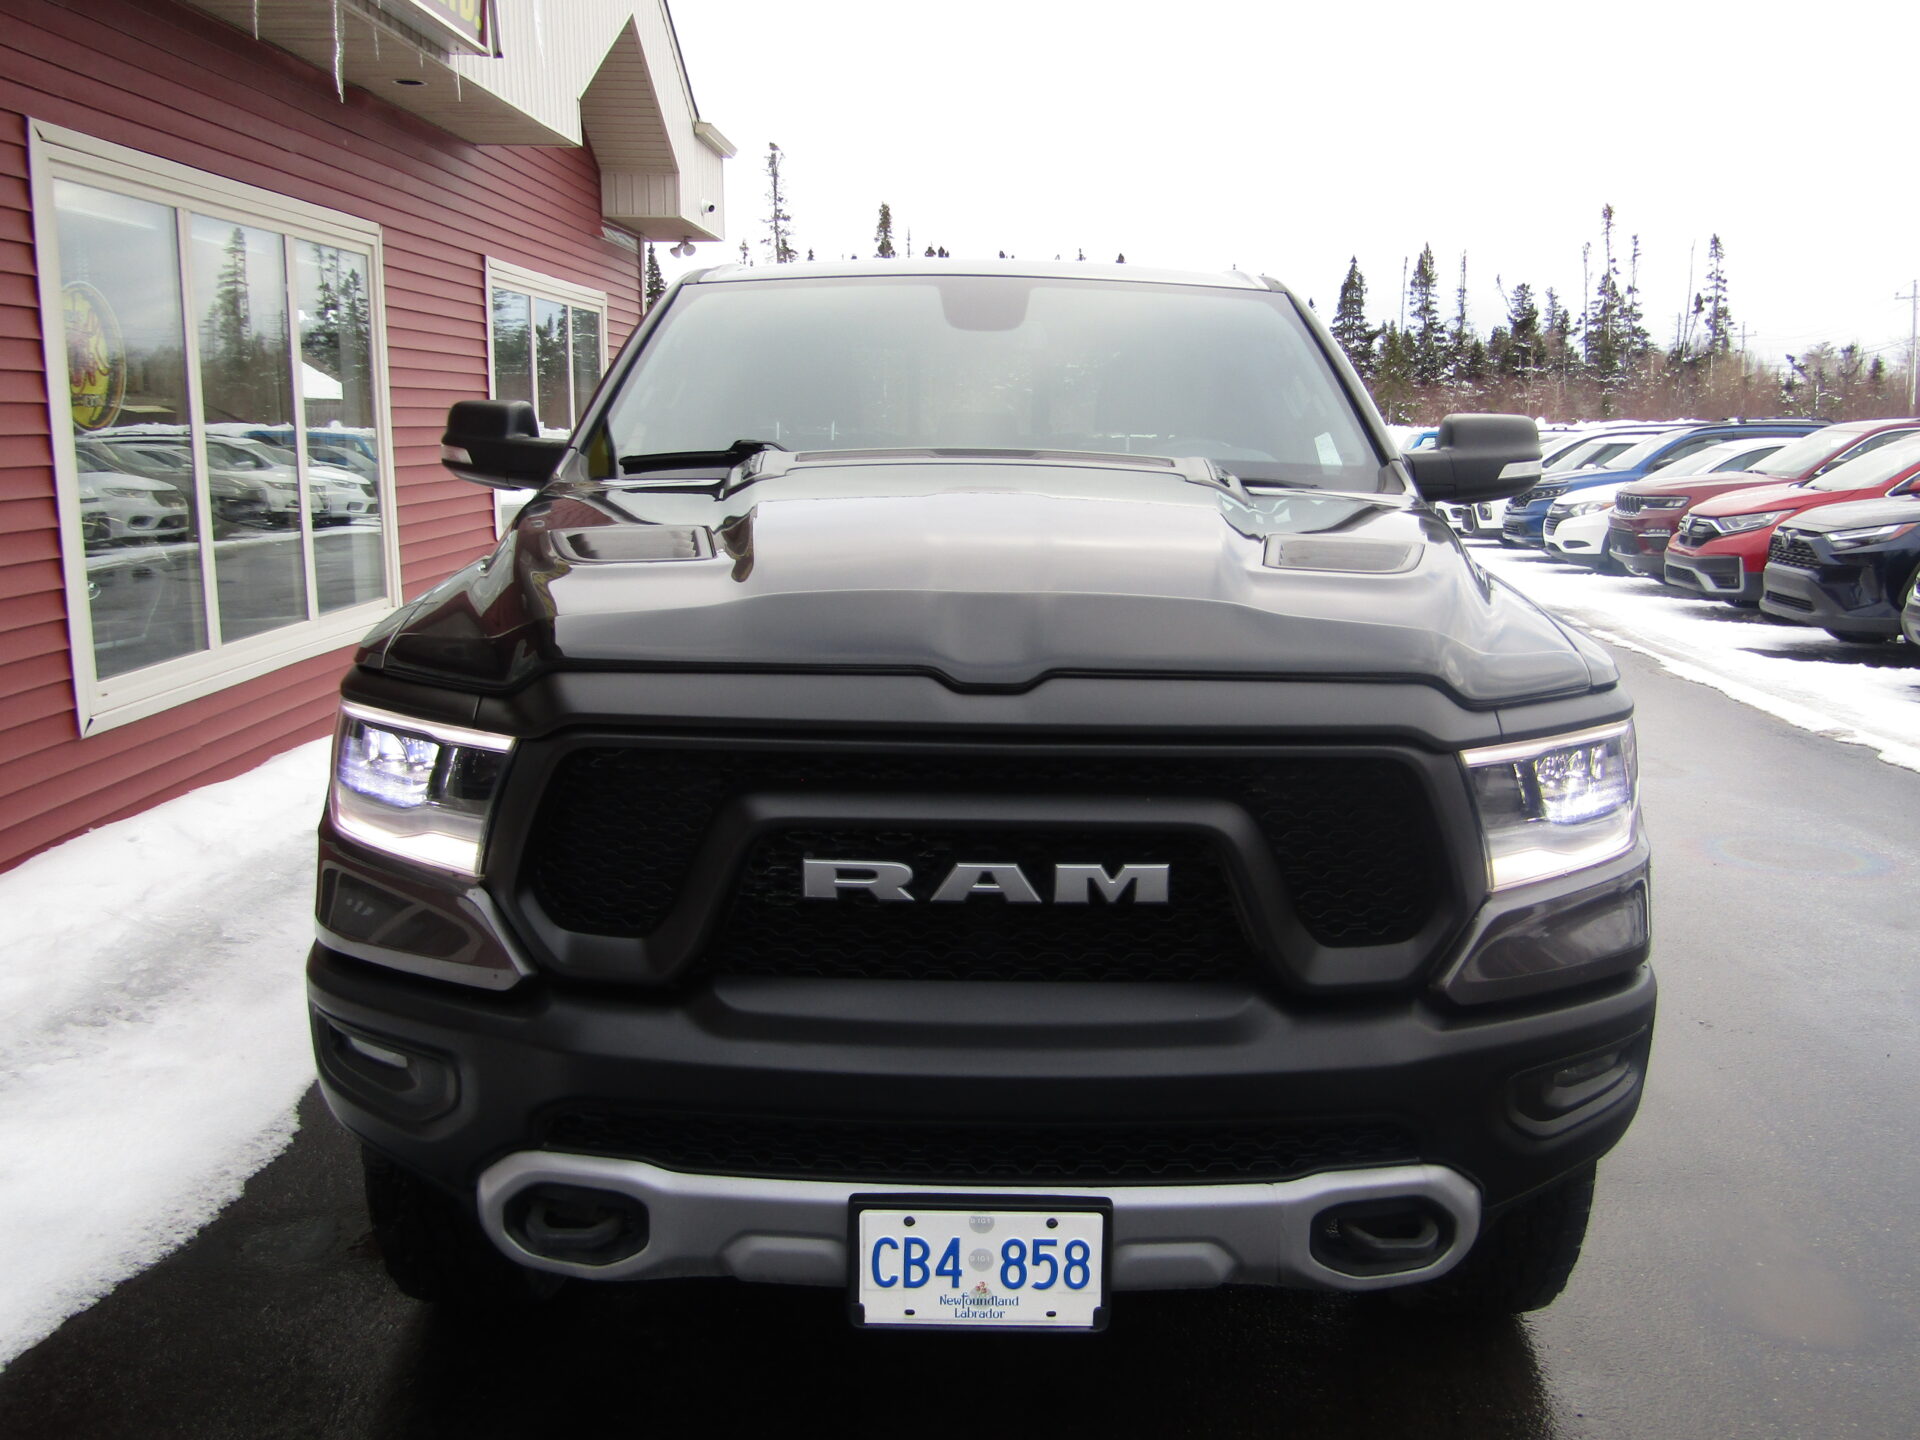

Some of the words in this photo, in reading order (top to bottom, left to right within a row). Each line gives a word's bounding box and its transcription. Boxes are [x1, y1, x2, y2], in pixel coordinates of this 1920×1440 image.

[803, 858, 1170, 903] RAM
[871, 1236, 963, 1289] CB4
[1000, 1238, 1091, 1290] 858
[939, 1292, 1019, 1309] Newfoundland
[954, 1307, 1006, 1319] Labrador
